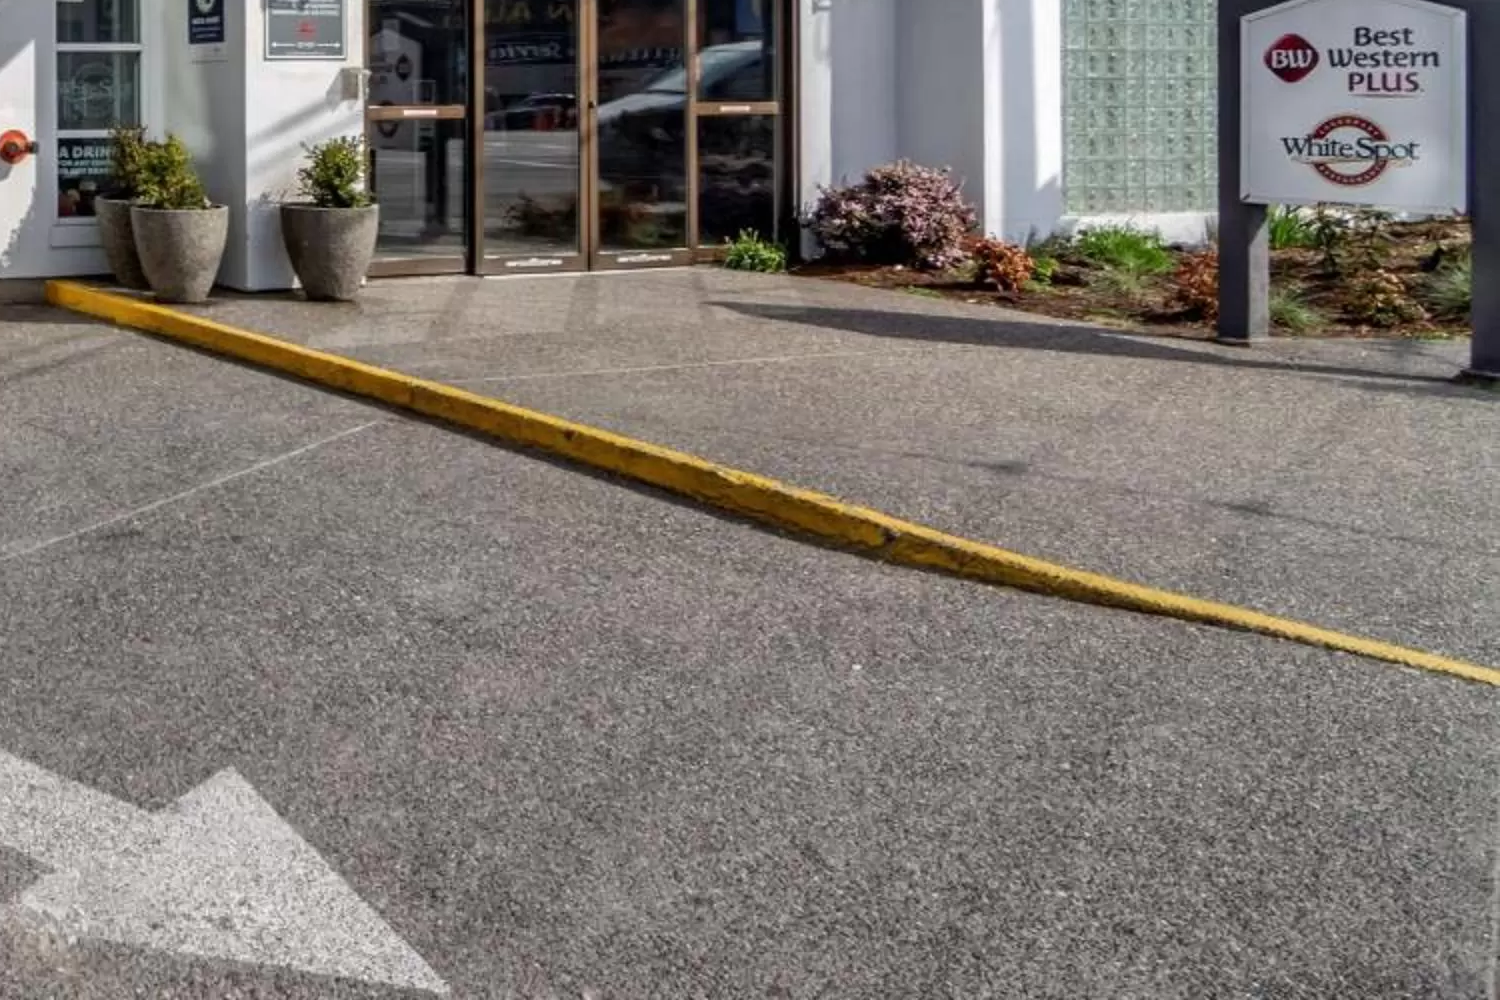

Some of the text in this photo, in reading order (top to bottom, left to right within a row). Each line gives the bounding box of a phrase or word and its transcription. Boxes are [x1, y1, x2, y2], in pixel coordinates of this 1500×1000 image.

[1353, 26, 1415, 47] Best
[1271, 49, 1313, 70] BW
[1328, 48, 1441, 69] Western
[1348, 71, 1421, 93] PLUS
